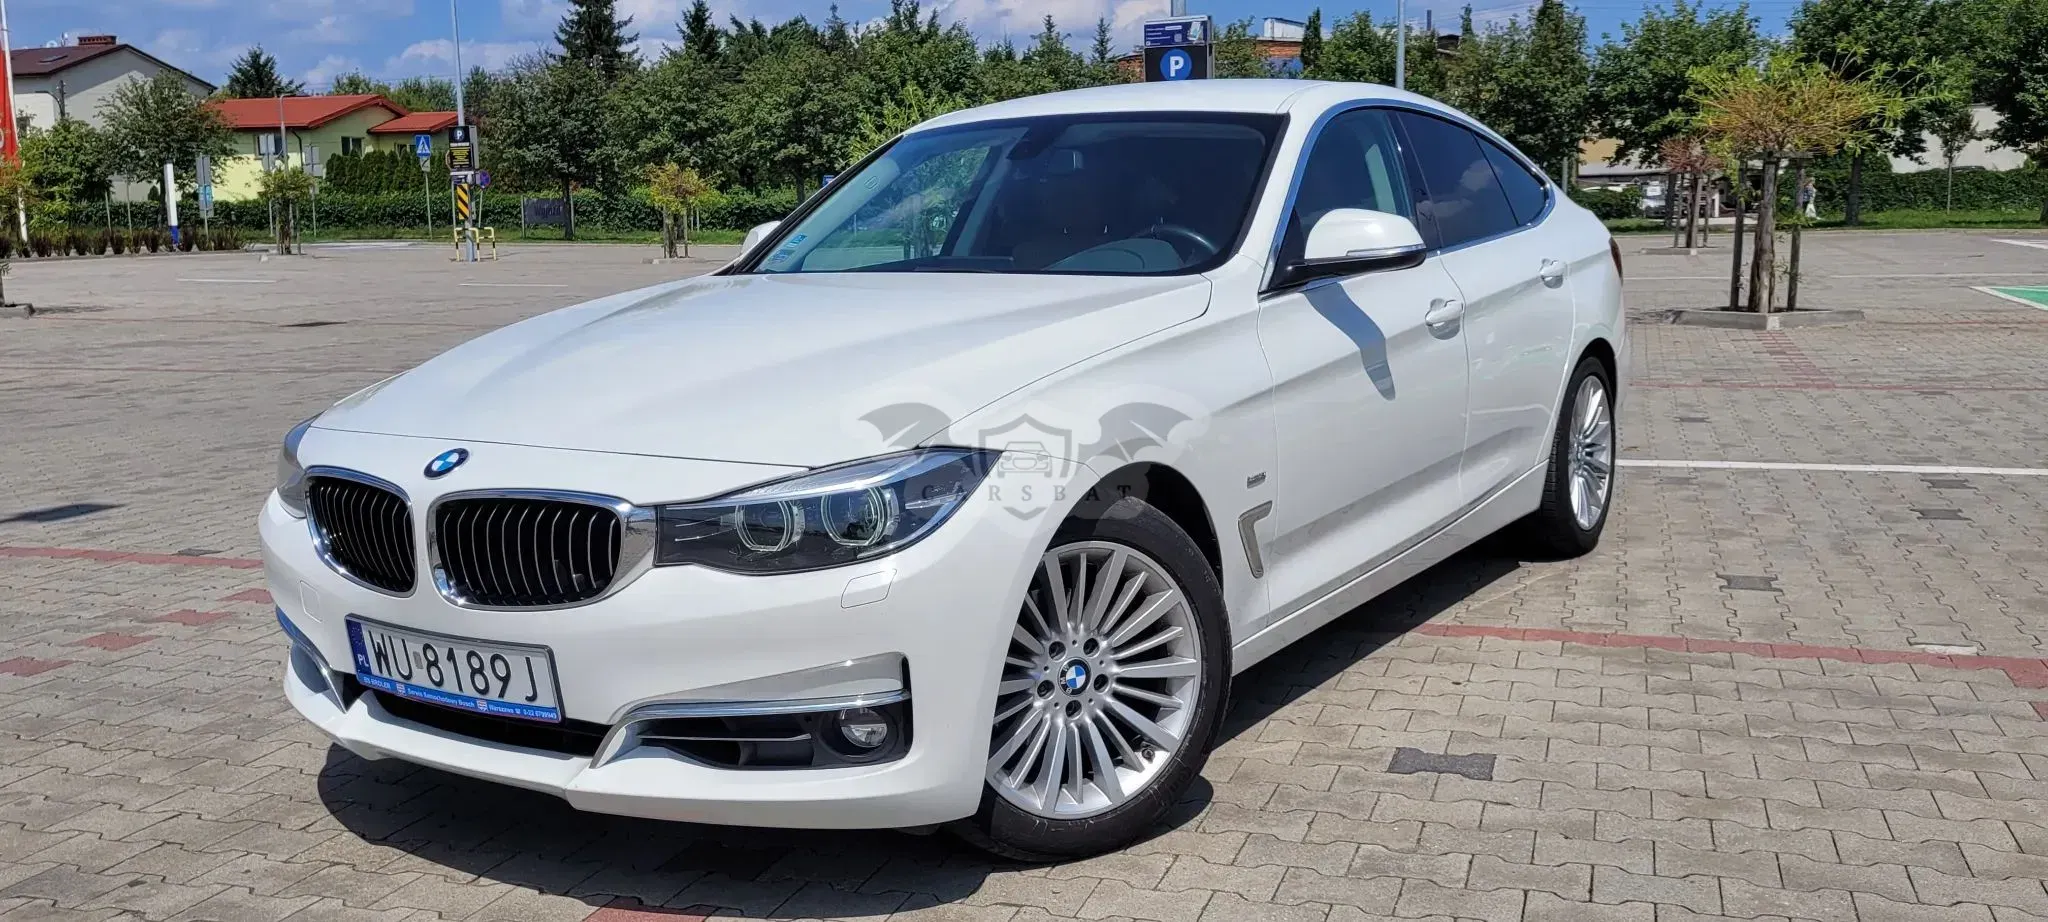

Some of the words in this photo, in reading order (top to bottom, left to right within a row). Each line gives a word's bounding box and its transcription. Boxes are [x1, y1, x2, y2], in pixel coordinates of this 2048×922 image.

[1169, 56, 1185, 77] P
[456, 130, 462, 140] P
[357, 654, 369, 668] PL
[368, 630, 413, 681] WU
